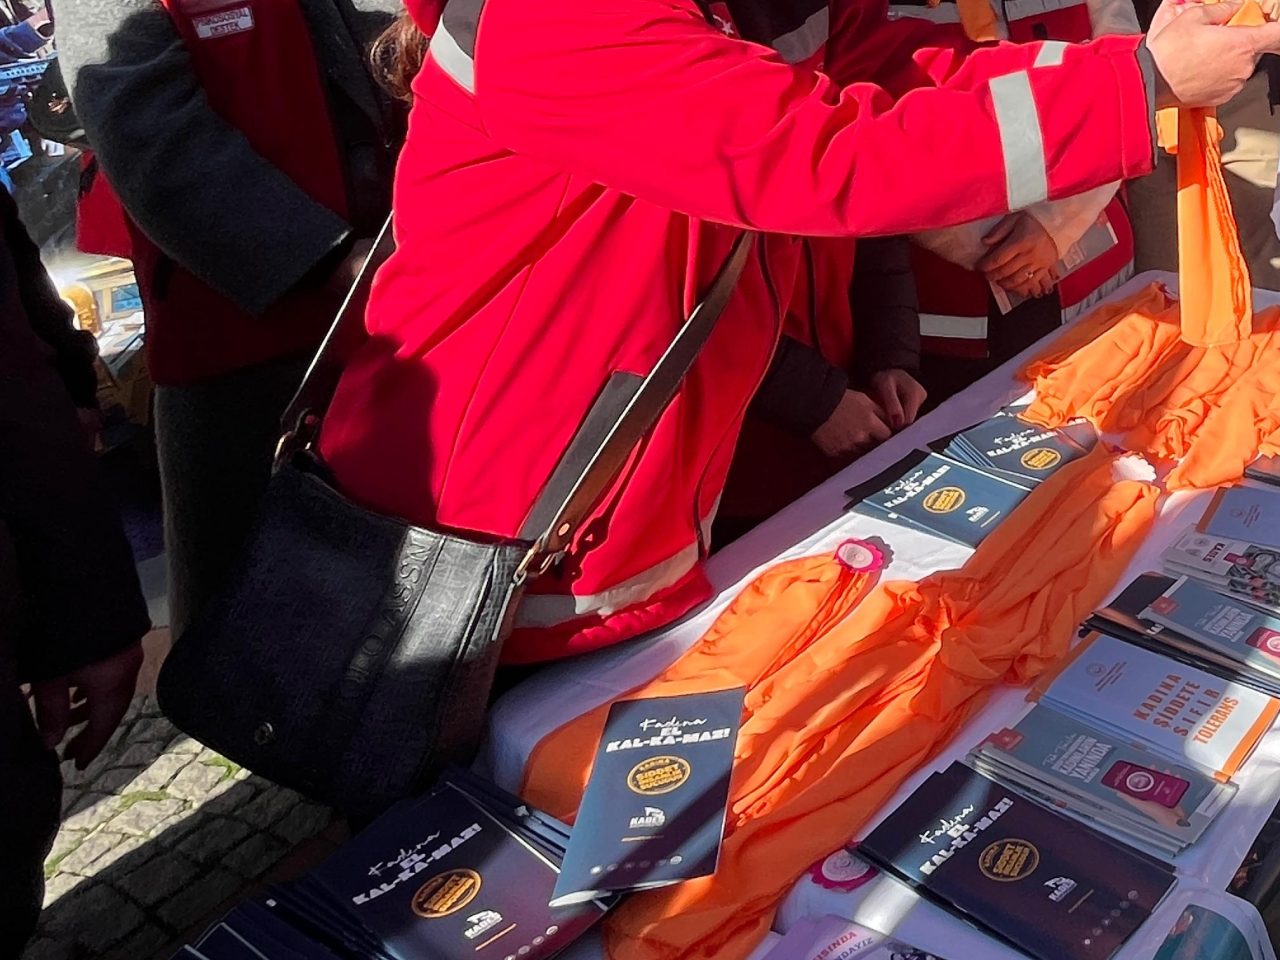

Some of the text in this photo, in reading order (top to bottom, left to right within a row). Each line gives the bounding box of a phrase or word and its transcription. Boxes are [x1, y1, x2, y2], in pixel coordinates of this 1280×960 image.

[1133, 673, 1182, 721] KADINA
[1153, 680, 1201, 729] ŞİDDETE
[1173, 688, 1220, 737] SIFIR
[1193, 696, 1240, 745] TOLERANS
[661, 726, 683, 737] EL
[946, 823, 971, 839] EL
[812, 930, 858, 960] ISINDA
